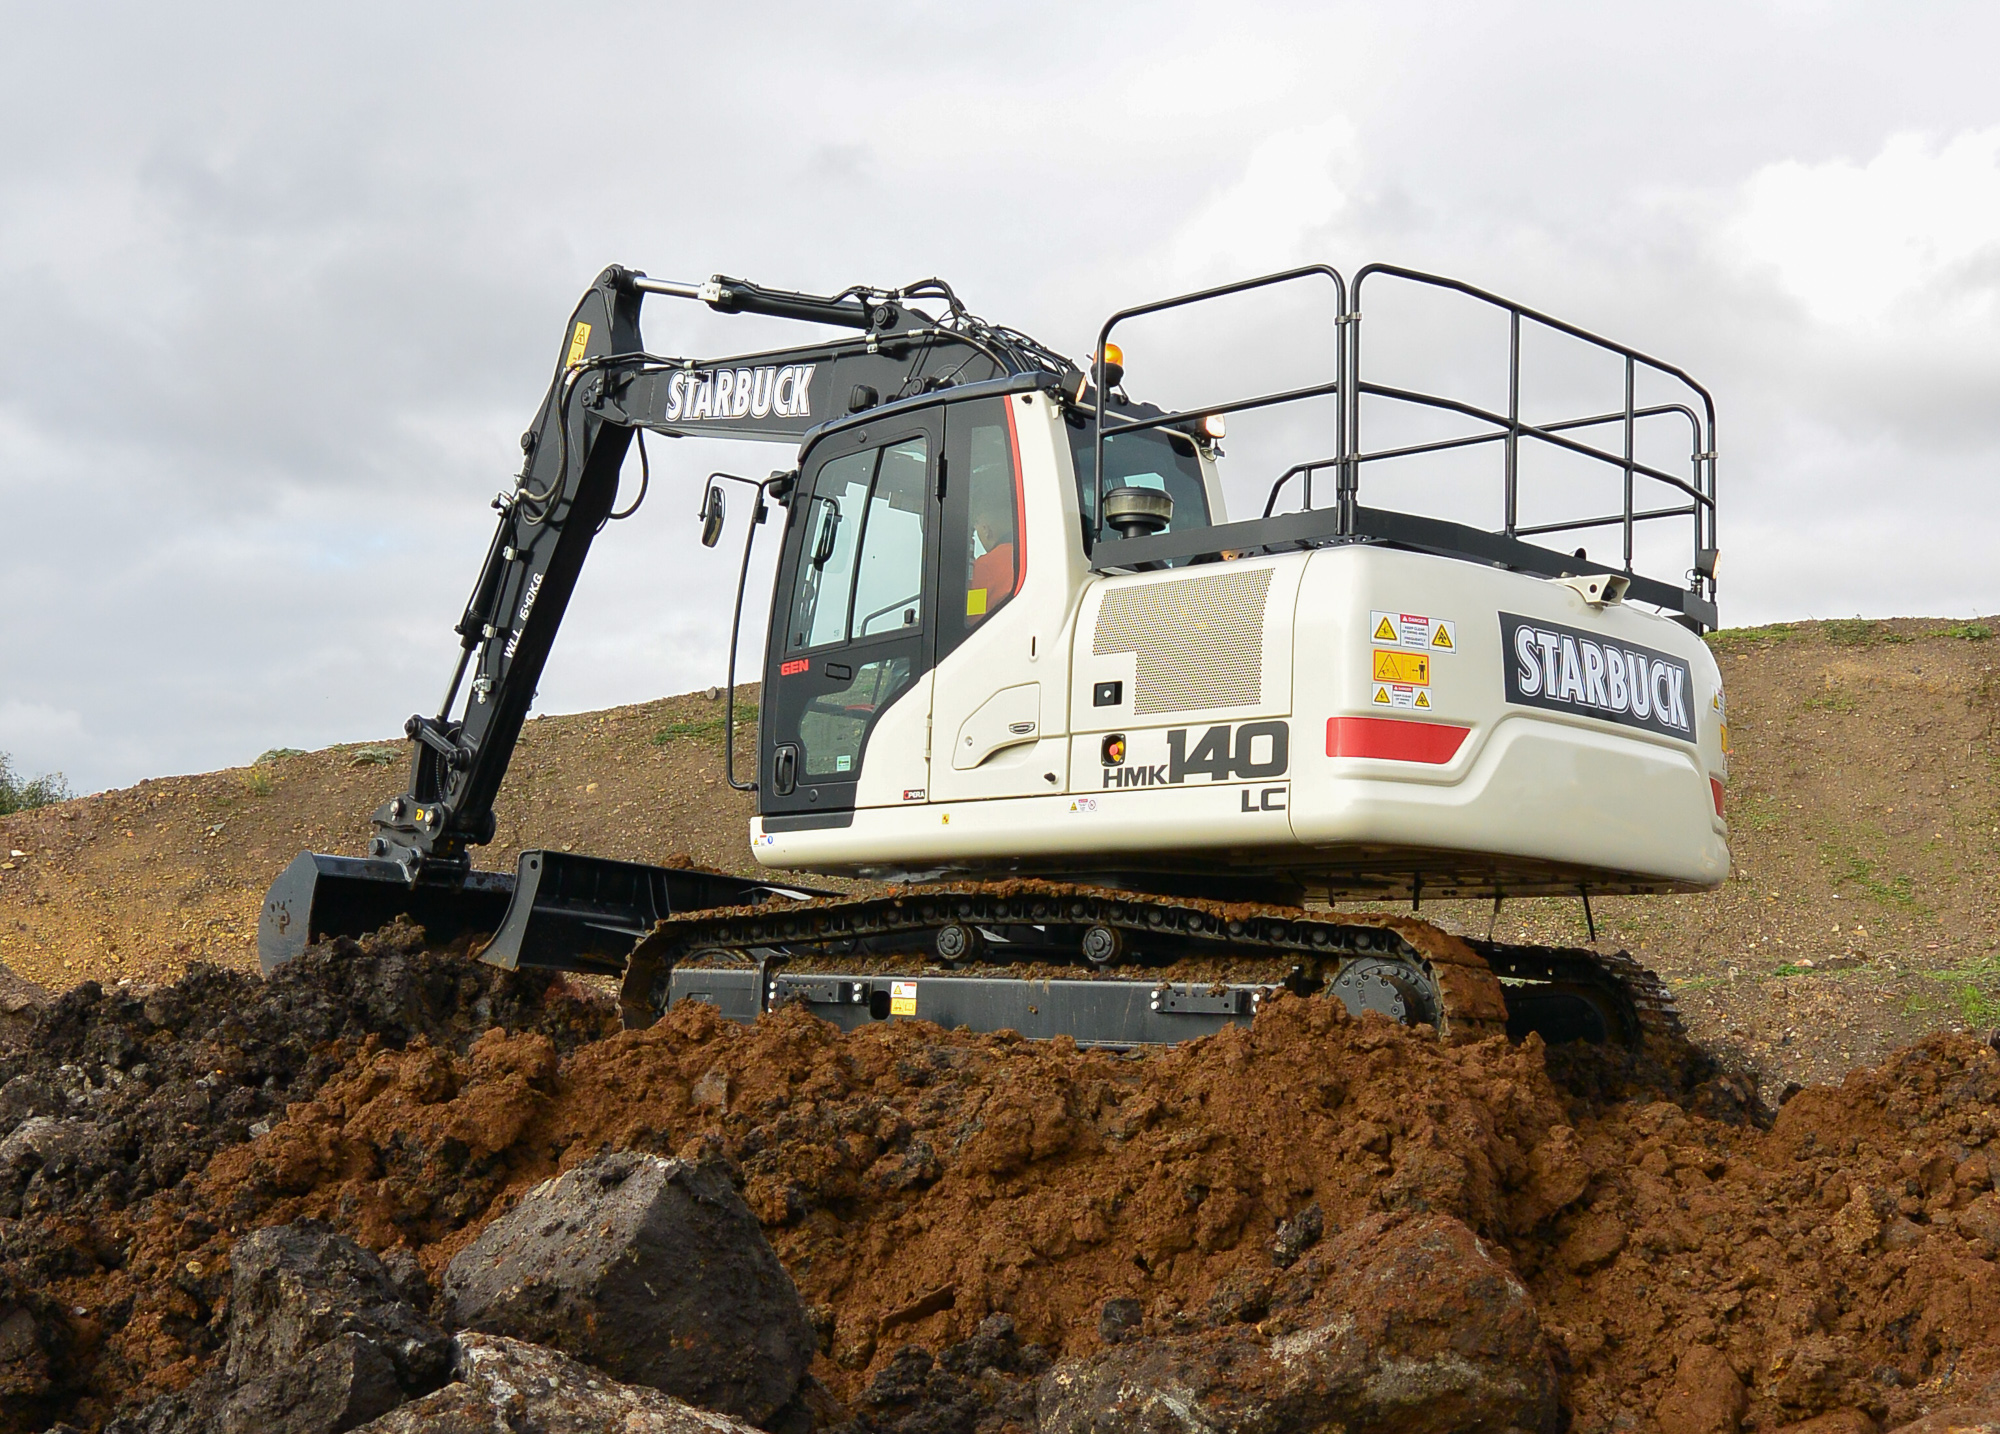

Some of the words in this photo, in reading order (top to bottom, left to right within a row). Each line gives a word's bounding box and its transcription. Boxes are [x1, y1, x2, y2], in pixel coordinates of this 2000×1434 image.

[666, 364, 816, 422] STARBUCK
[1408, 616, 1427, 624] DANGER
[781, 658, 809, 676] GEN
[1515, 625, 1690, 732] STARBUCK
[1102, 764, 1168, 788] HMK
[1167, 720, 1289, 784] 140
[904, 789, 925, 799] OPERA
[1241, 787, 1287, 812] LC
